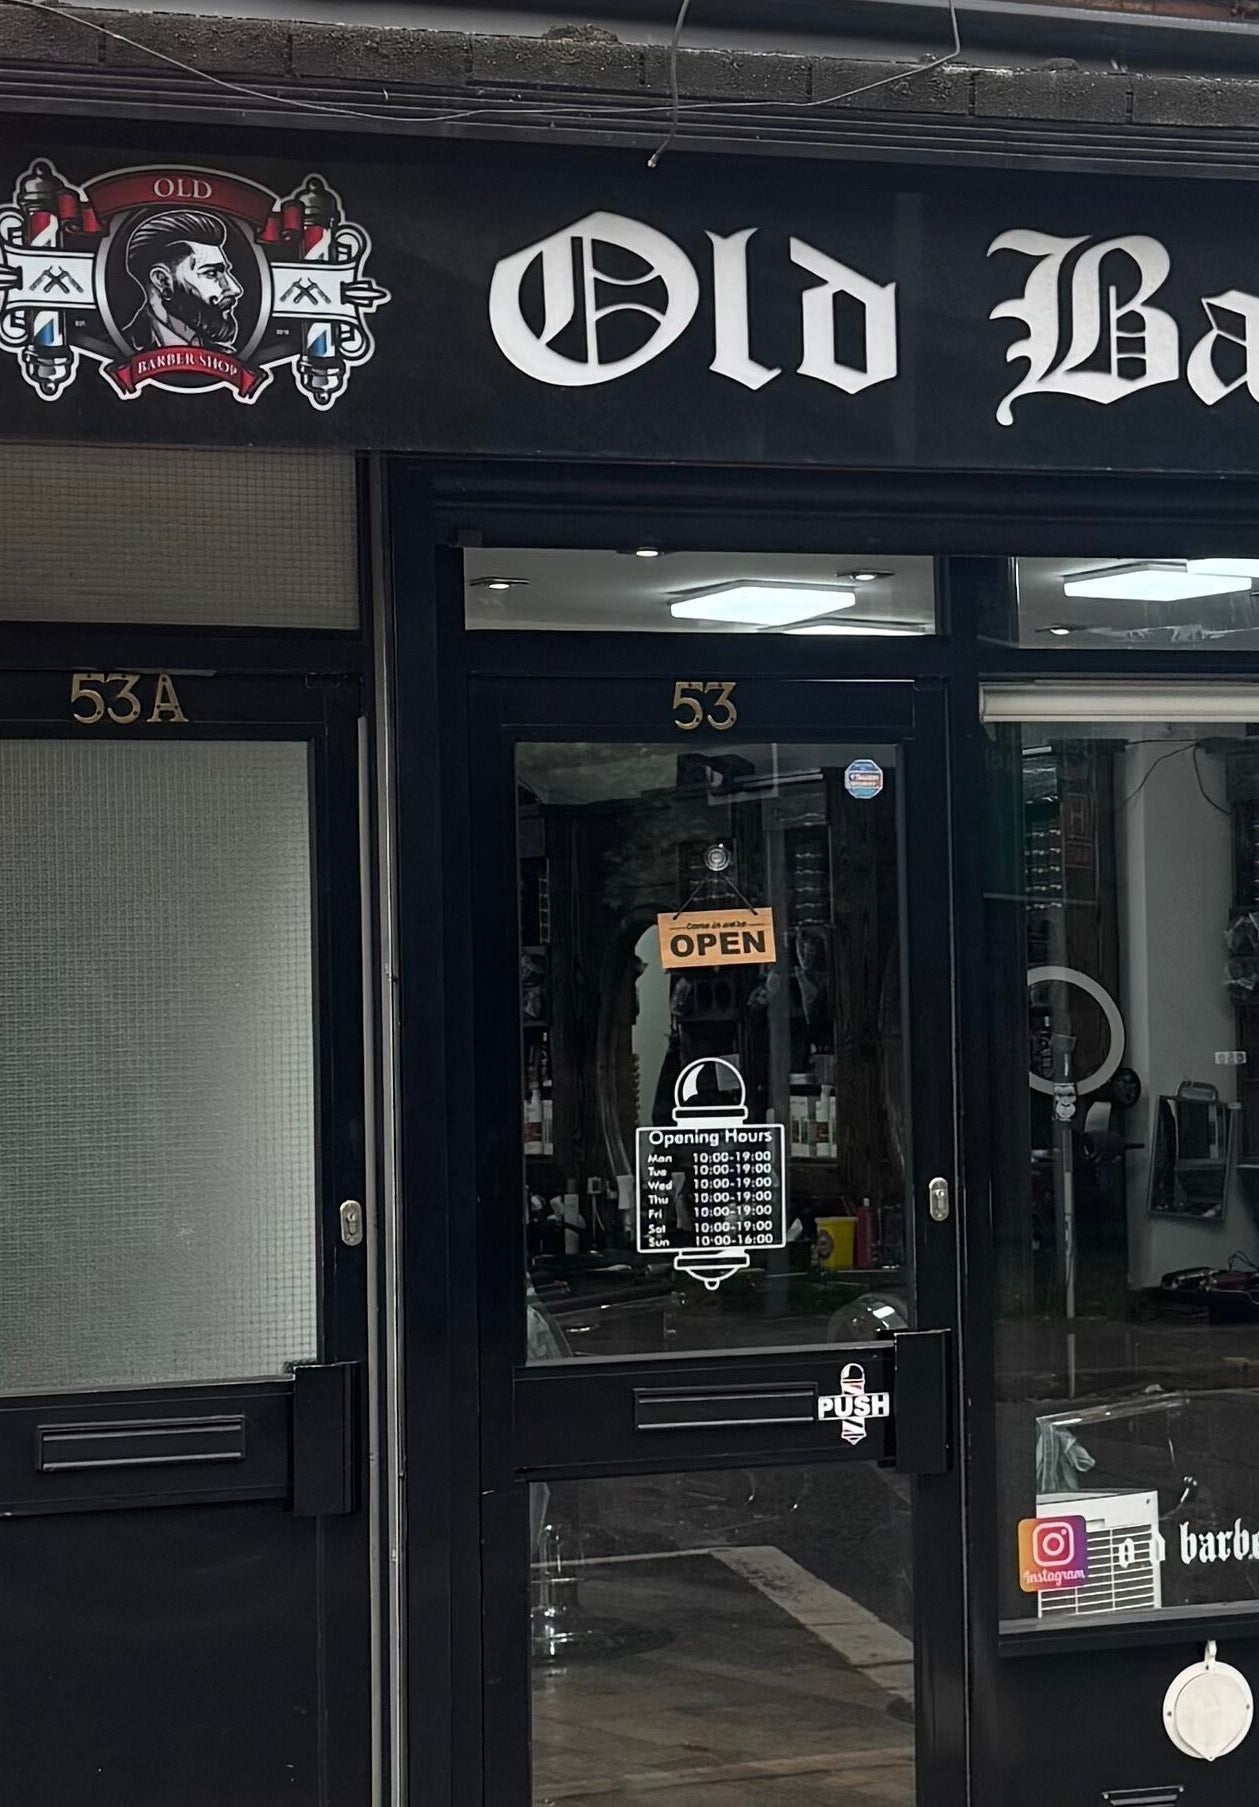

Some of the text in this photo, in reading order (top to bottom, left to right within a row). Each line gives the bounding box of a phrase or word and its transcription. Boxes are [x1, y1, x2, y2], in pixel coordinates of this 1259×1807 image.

[153, 177, 213, 199] OLD
[488, 210, 898, 395] Old
[137, 352, 239, 377] BARBER SHOP
[70, 672, 190, 725] 53A
[672, 681, 738, 731] 53
[670, 930, 766, 958] OPEN
[648, 1128, 773, 1149] Opening Hours
[647, 1150, 772, 1164] Mon 10:00-19:00
[648, 1162, 772, 1177] Tue 10:00-19:00
[647, 1176, 772, 1191] Wed 10:00-19:00
[648, 1190, 773, 1205] Thu 10:00-19:00
[648, 1204, 773, 1219] Fri 10:00-19:00
[648, 1220, 774, 1235] Sat 10:00-19:00
[648, 1233, 774, 1248] Sun 10:00-16:00
[818, 1396, 889, 1420] PUSH
[1118, 1528, 1166, 1569] od
